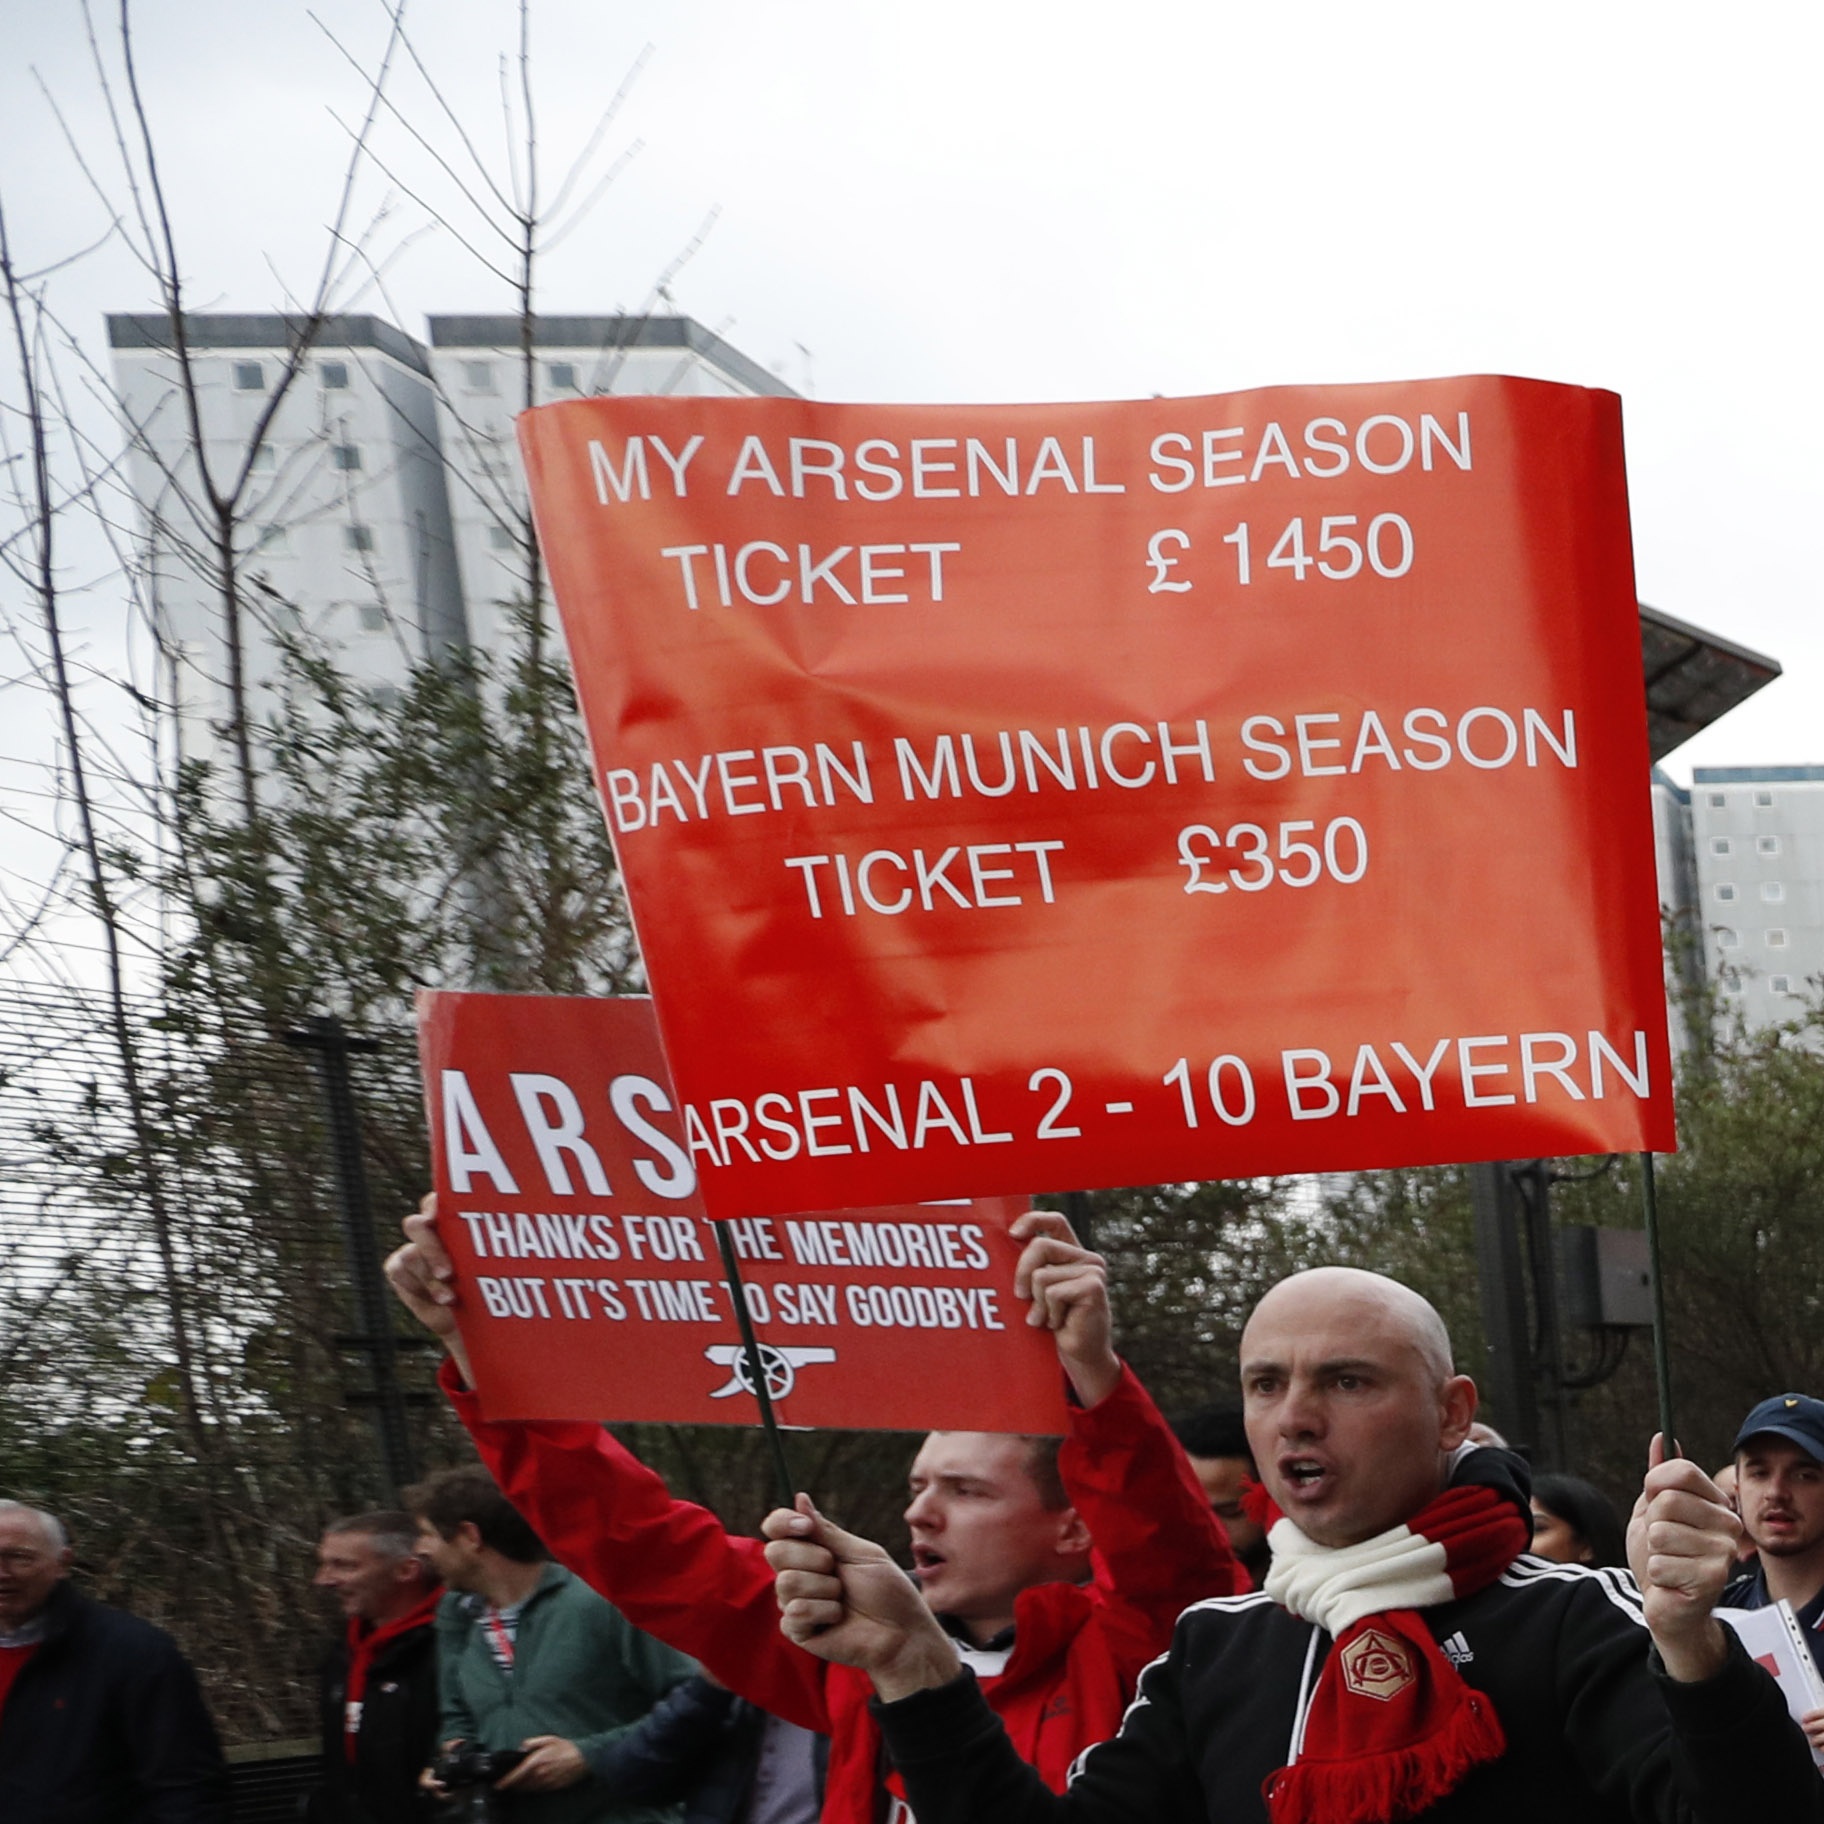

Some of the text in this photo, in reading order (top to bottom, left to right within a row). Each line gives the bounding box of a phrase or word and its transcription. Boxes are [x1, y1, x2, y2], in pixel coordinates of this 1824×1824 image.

[589, 412, 1472, 505] MY ARSENAL SEASON
[661, 542, 960, 610] TICKET
[1223, 513, 1414, 586] 1450
[606, 709, 1577, 832] BAYERN MUNICH SEASON
[785, 815, 1368, 919] TICKET £350
[684, 1076, 1012, 1168] ARSENAL
[1028, 1067, 1081, 1140] 2
[1163, 1055, 1254, 1128] 10
[1281, 1030, 1650, 1121] BAYERN
[459, 1211, 620, 1260] THANKS
[625, 1214, 705, 1261] FOR
[786, 1220, 990, 1270] MEMORIES
[476, 1276, 545, 1319] BUT
[625, 1279, 722, 1323] TIME
[773, 1283, 838, 1327] SAY
[846, 1285, 1004, 1331] GOODBYE
